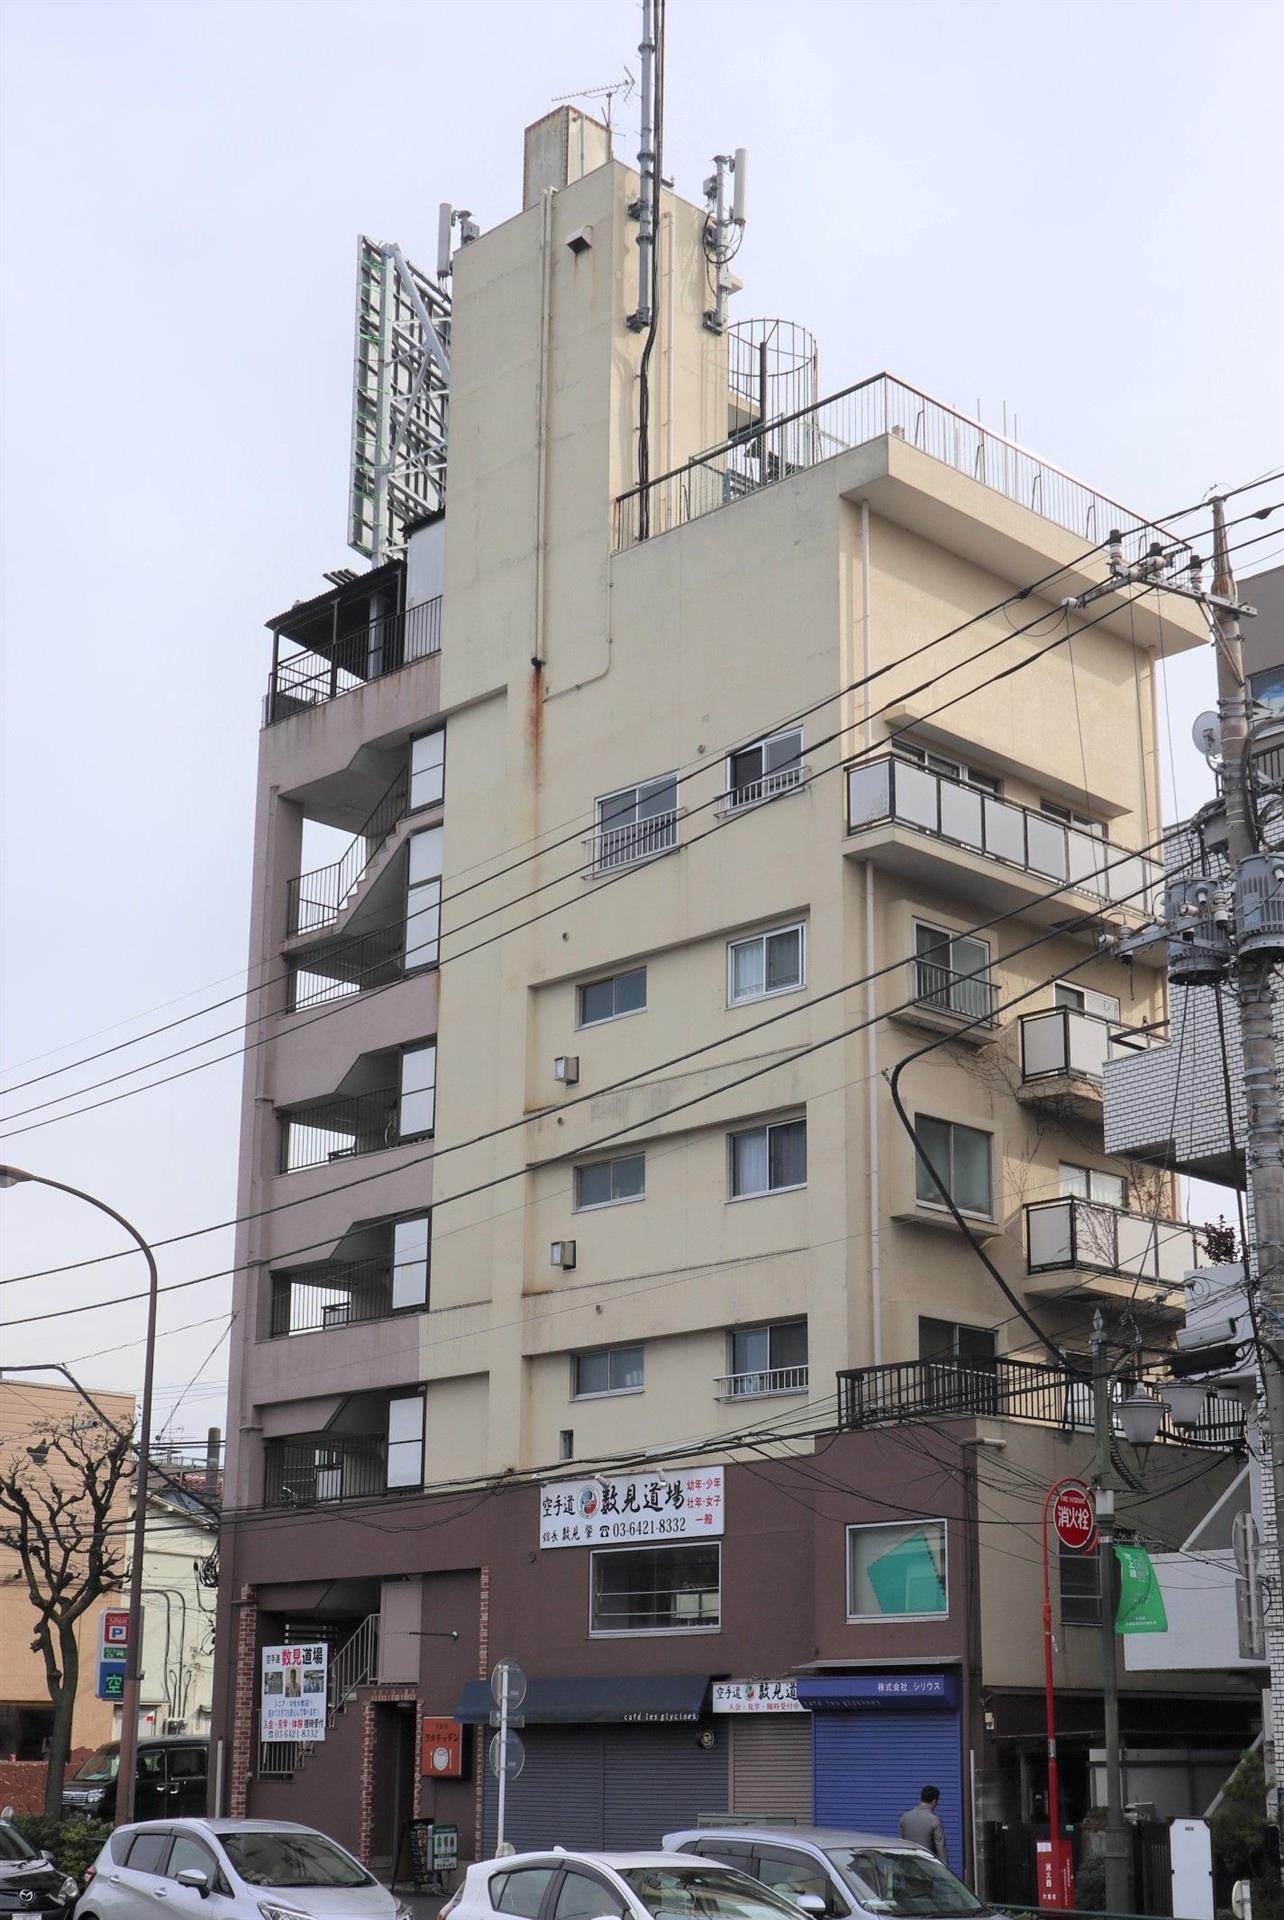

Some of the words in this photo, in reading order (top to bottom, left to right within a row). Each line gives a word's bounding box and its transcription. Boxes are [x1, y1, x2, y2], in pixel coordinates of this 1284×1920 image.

[542, 1494, 576, 1518] 空手道
[695, 1513, 713, 1525] 一般
[1058, 1505, 1089, 1530] 消火栓
[613, 1517, 686, 1537] 03-6421-8332
[111, 1627, 123, 1638] P
[281, 1647, 323, 1666] 数見道場
[105, 1675, 122, 1693] 空
[877, 1682, 907, 1692] 株式会社
[913, 1681, 941, 1691] シリウス
[716, 1686, 742, 1700] 空手道
[624, 1712, 641, 1721] café
[645, 1712, 658, 1721] les
[660, 1712, 697, 1722] glycines
